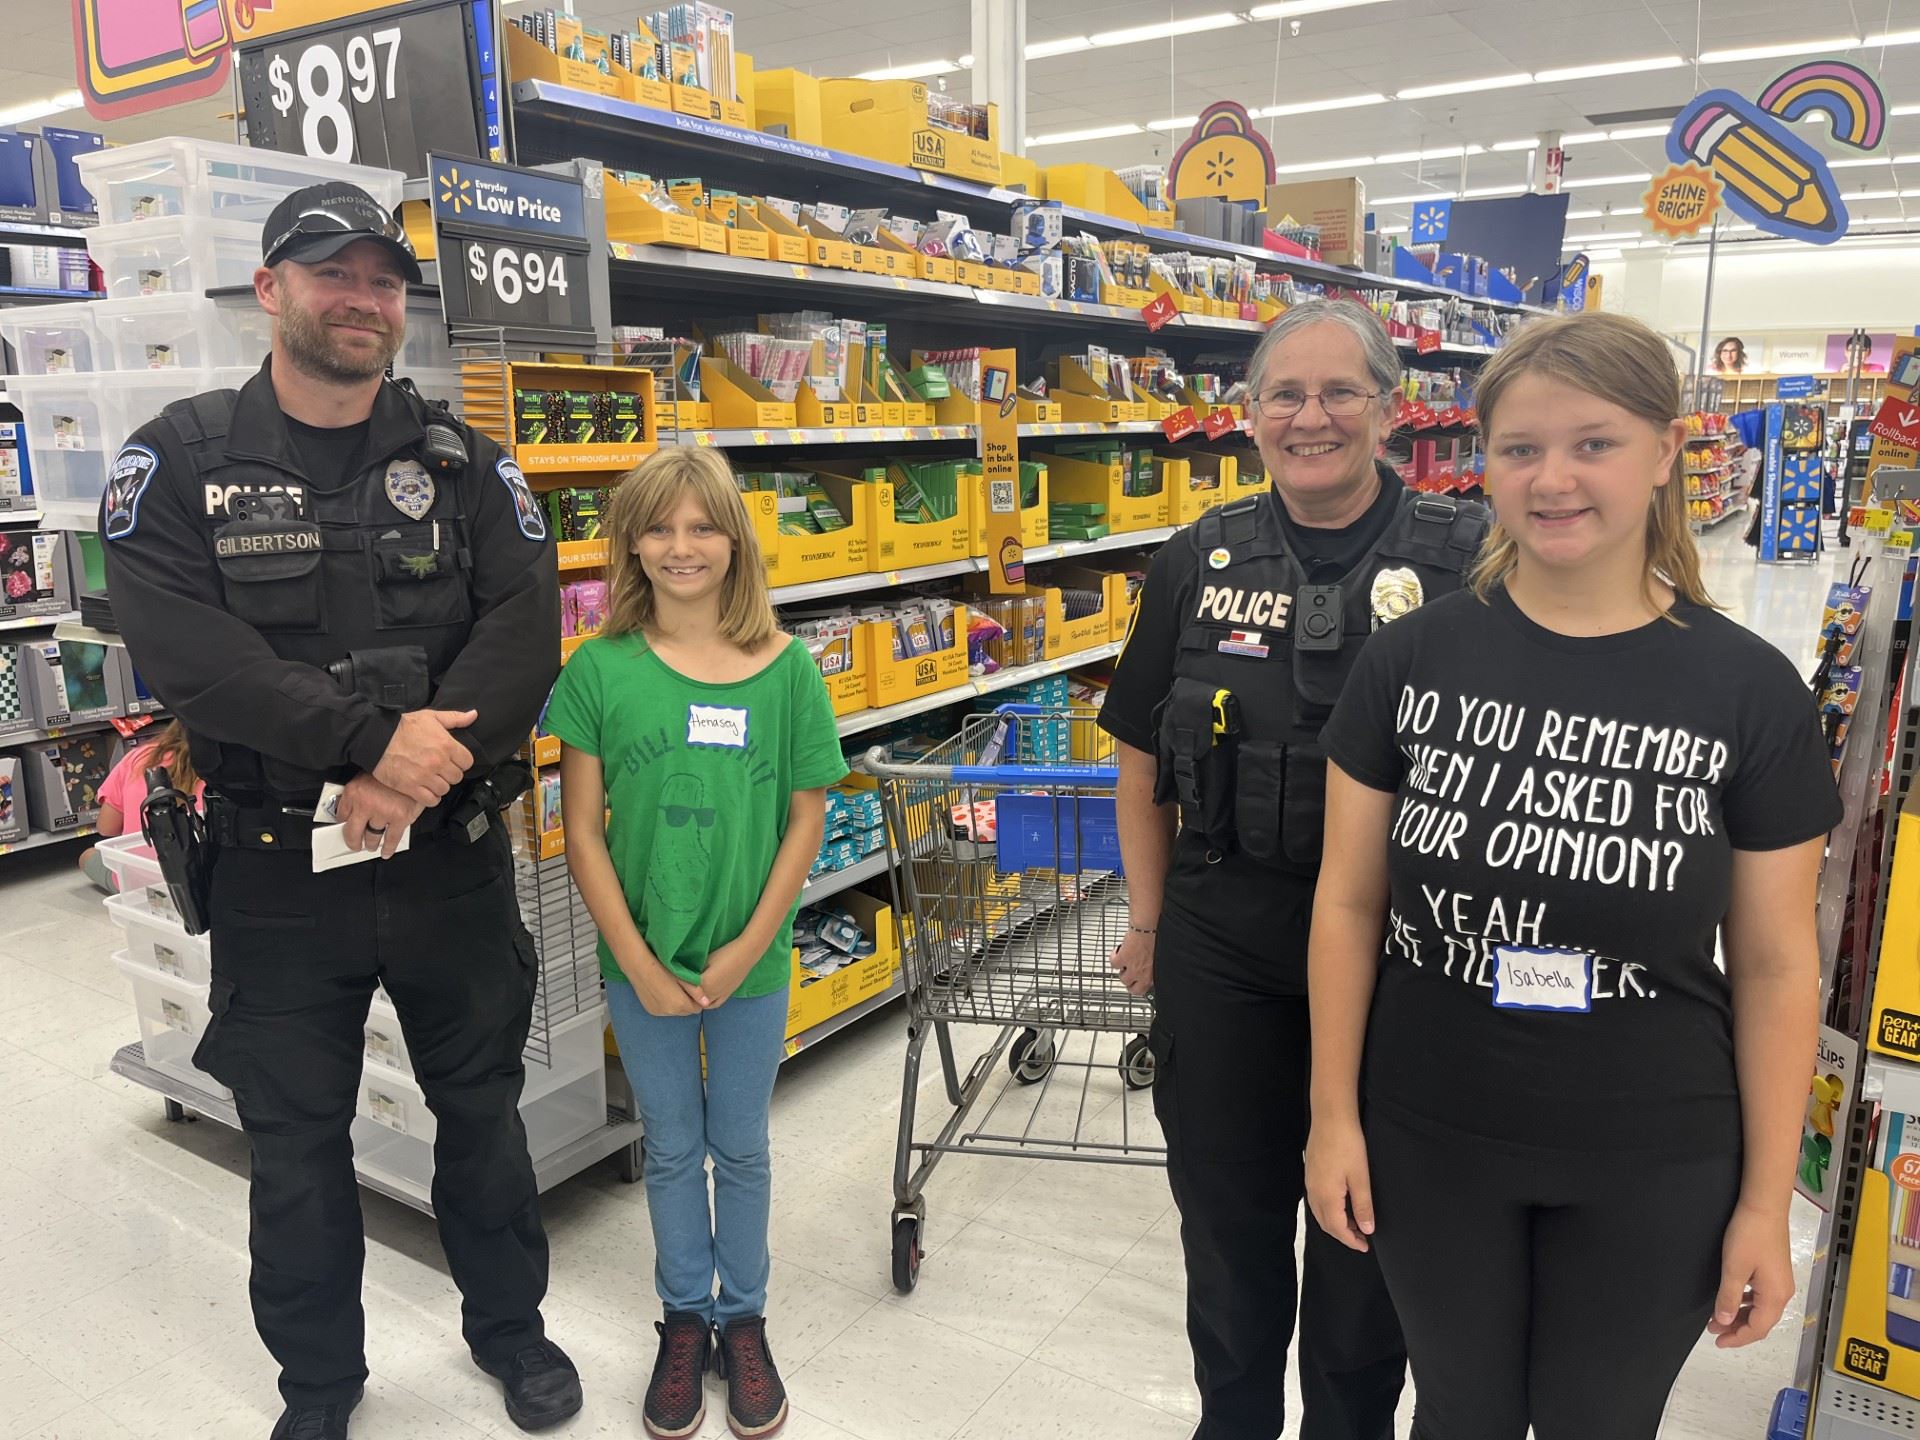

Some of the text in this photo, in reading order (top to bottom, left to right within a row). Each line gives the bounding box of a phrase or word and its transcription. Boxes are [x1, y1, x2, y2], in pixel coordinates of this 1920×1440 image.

[489, 91, 494, 101] 4
[488, 126, 498, 136] 20
[676, 117, 691, 128] Ask
[704, 124, 742, 140] assistance
[743, 134, 760, 143] with
[760, 136, 778, 147] items
[918, 134, 942, 156] USA
[475, 180, 508, 195] Everyday
[1660, 183, 1706, 202] SHINE
[476, 189, 562, 223] Low Price
[1658, 200, 1704, 220] BRIGHT
[1151, 310, 1176, 332] Rollback
[1780, 350, 1809, 360] Women
[1873, 422, 1918, 448] Rollback
[986, 443, 1007, 453] Shop
[987, 454, 1014, 462] in bulk
[1878, 448, 1910, 458] online
[528, 456, 555, 465] STAYS
[557, 456, 568, 464] ON
[571, 456, 610, 464] THROUGH
[611, 455, 630, 463] PLAY
[987, 464, 1012, 474] online
[881, 492, 888, 500] 24
[1768, 472, 1776, 506] Shopping
[205, 484, 304, 516] POE
[764, 498, 770, 506] 12
[216, 532, 322, 554] GILBERTSON
[1197, 586, 1292, 629] POLICE
[914, 636, 928, 646] USA
[824, 656, 840, 668] USA
[918, 666, 934, 677] USA
[1397, 685, 1728, 785] DO YOU REMEMBER
[1480, 763, 1500, 807] I
[1506, 766, 1632, 826] ASKED
[1655, 784, 1715, 836] FOR
[1392, 796, 1684, 892] YOUR OPINION?
[1422, 884, 1546, 945] YEAH
[1444, 935, 1657, 999] NEER.
[1507, 962, 1574, 990] Isabella
[1882, 1014, 1920, 1031] pen+
[1884, 1026, 1917, 1048] GEAR
[1816, 1046, 1845, 1070] LIPS
[1904, 1160, 1920, 1175] 67
[1848, 1343, 1885, 1360] pen+
[1850, 1354, 1881, 1375] GEAR
